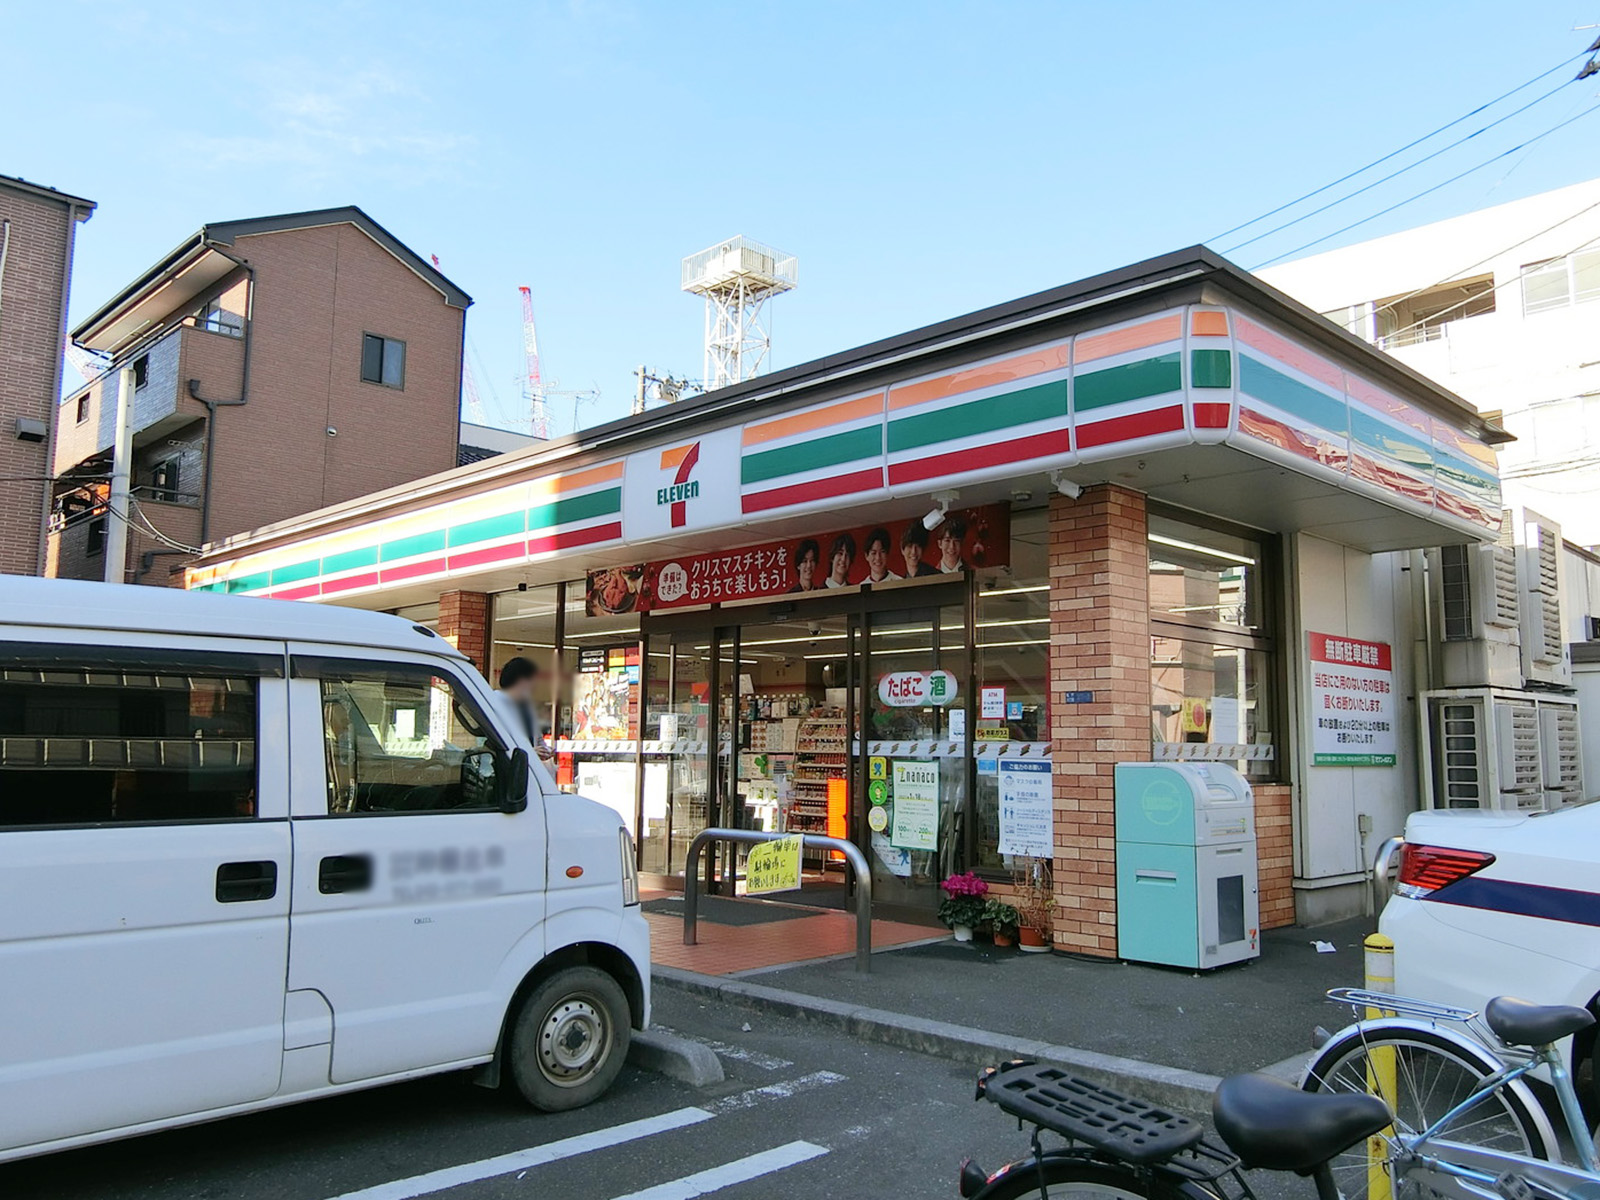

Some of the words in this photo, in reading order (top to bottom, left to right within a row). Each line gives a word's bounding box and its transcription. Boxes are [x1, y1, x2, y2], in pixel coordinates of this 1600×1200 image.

[660, 441, 700, 528] 7
[691, 546, 787, 579] クリスマスチキンを
[663, 572, 681, 583] 準備は
[1325, 639, 1379, 665] 無断駐車厳禁
[888, 676, 923, 697] たばこ
[930, 676, 946, 696] 酒
[1315, 673, 1390, 694] 当店にご用のない方の駐車は
[906, 771, 935, 783] nanaco
[763, 839, 798, 855] 二輪車は
[754, 856, 786, 872] 駐輪場に
